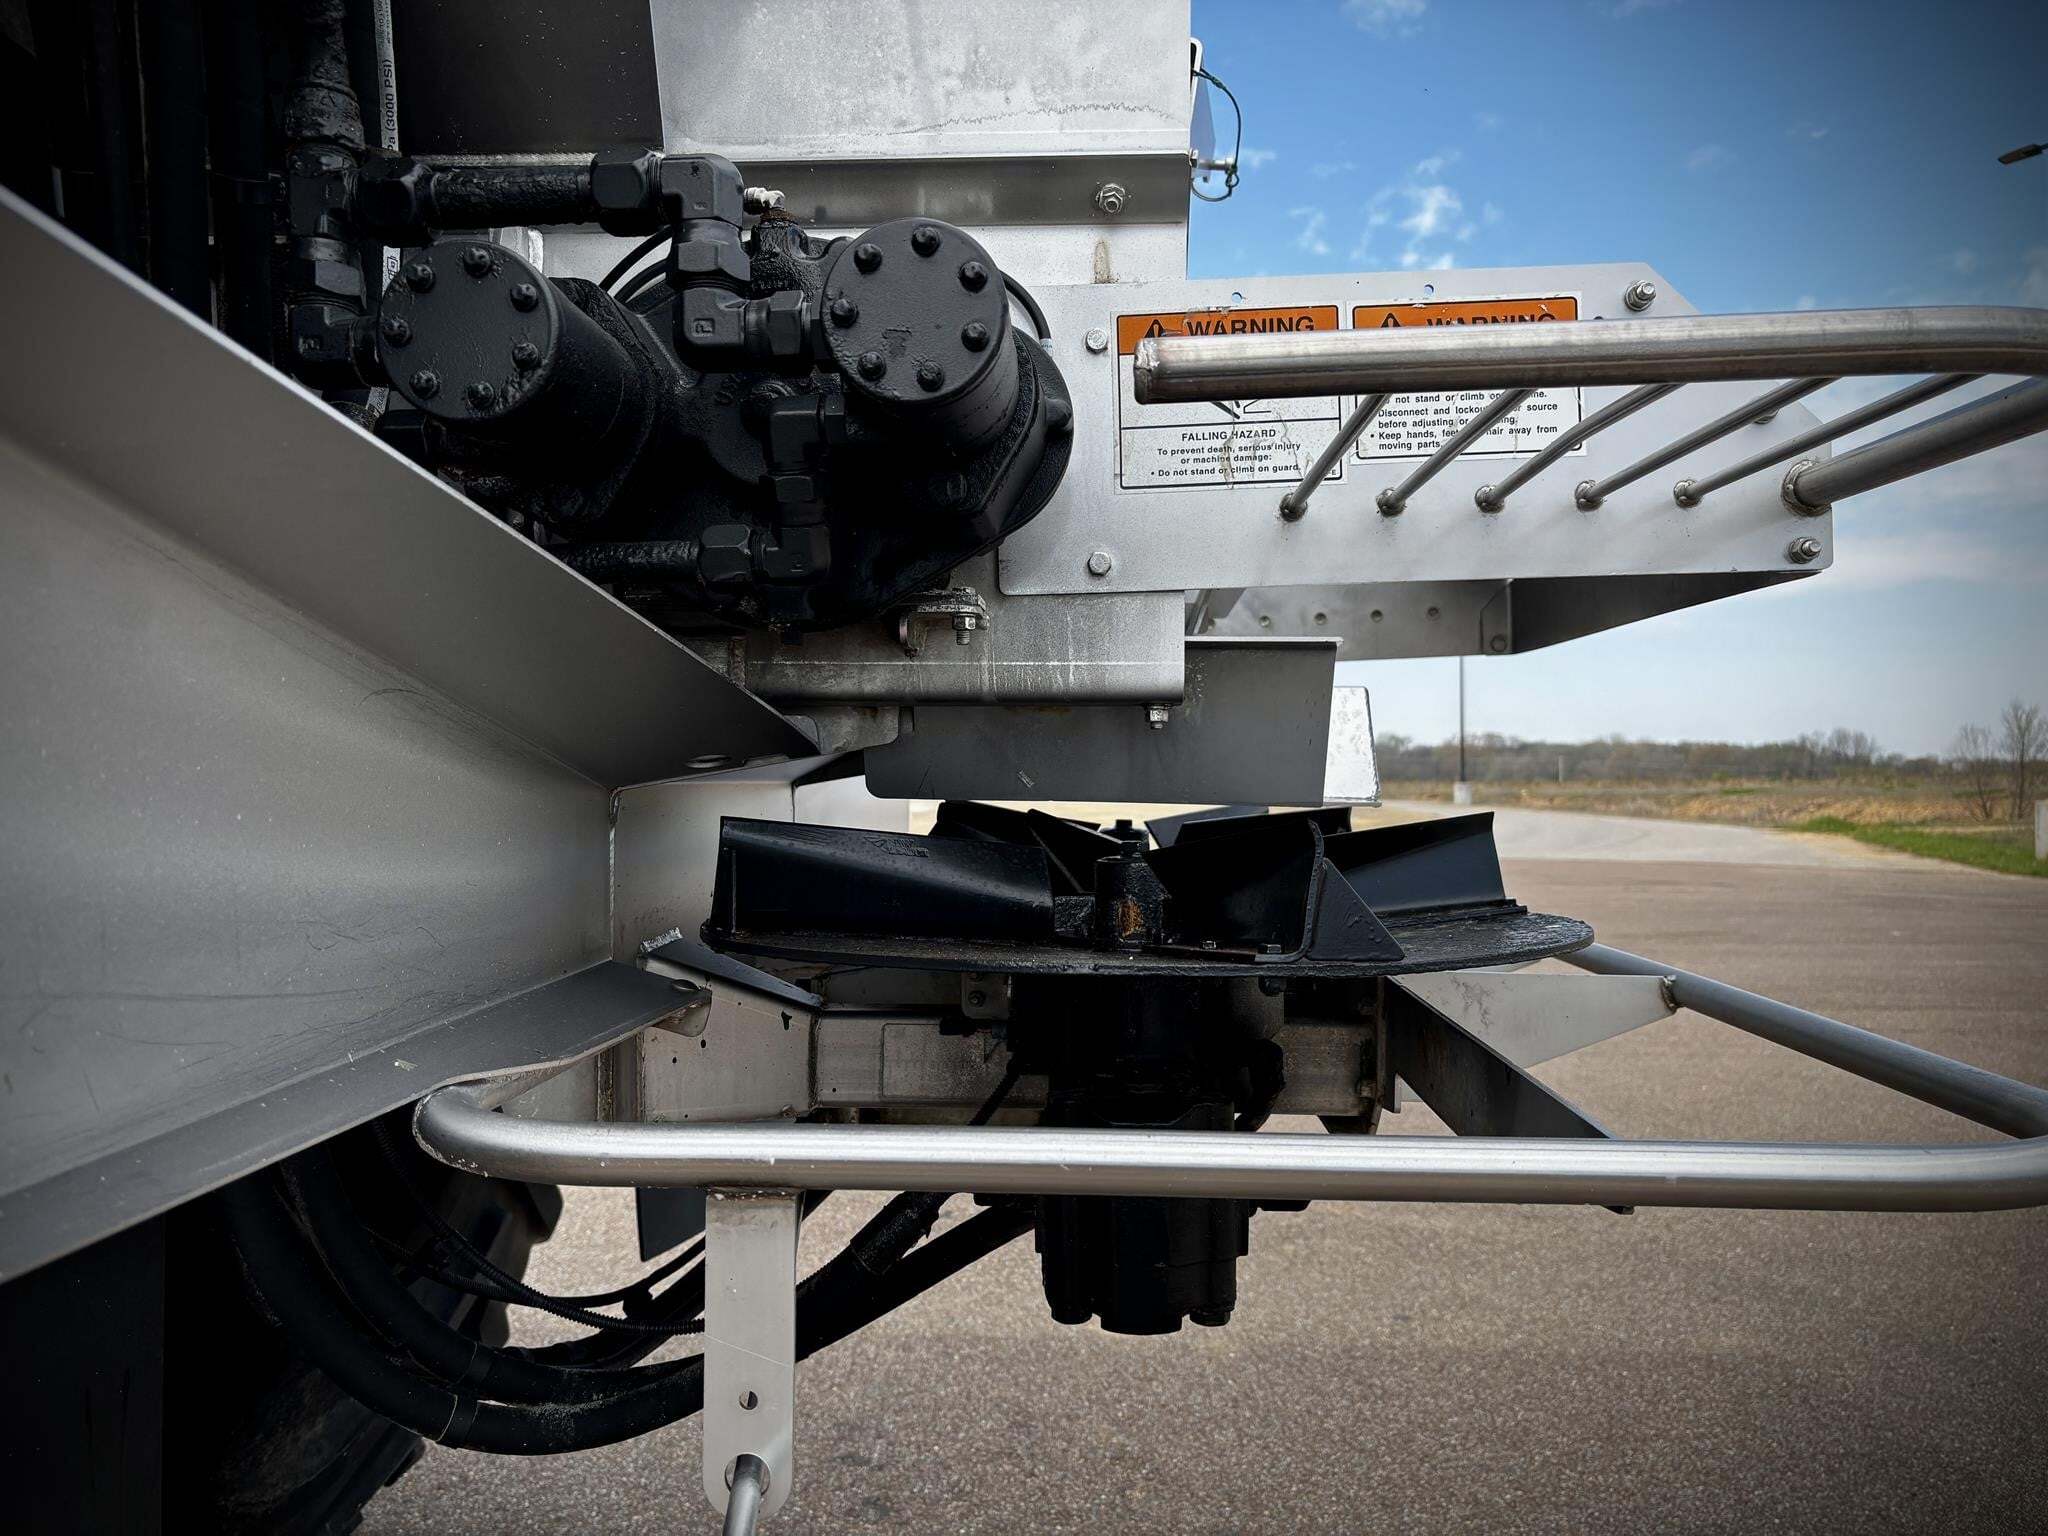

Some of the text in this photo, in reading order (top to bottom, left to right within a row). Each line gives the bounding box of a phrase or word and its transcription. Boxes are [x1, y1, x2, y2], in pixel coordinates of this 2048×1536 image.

[384, 93, 397, 131] (3000
[1186, 315, 1315, 336] WARNING
[1395, 395, 1410, 404] not
[1415, 394, 1440, 403] stand
[1460, 392, 1485, 401] climb
[1378, 407, 1429, 418] Disconnect
[1433, 406, 1450, 415] and
[1526, 403, 1558, 411] source
[1378, 418, 1469, 429] before adjusting or
[1181, 429, 1276, 442] FALLING HAZARD
[1378, 431, 1402, 441] Keep
[1406, 430, 1437, 439] hands,
[1508, 427, 1532, 436] away
[1536, 425, 1558, 433] from
[1157, 442, 1301, 456] To prevent death, serious injury
[1378, 441, 1412, 451] moving
[1180, 453, 1273, 465] or machine damage:
[1158, 469, 1170, 477] Do
[1172, 468, 1188, 476] not
[1190, 467, 1216, 476] stand
[1230, 465, 1255, 474] climb
[1257, 465, 1270, 473] on
